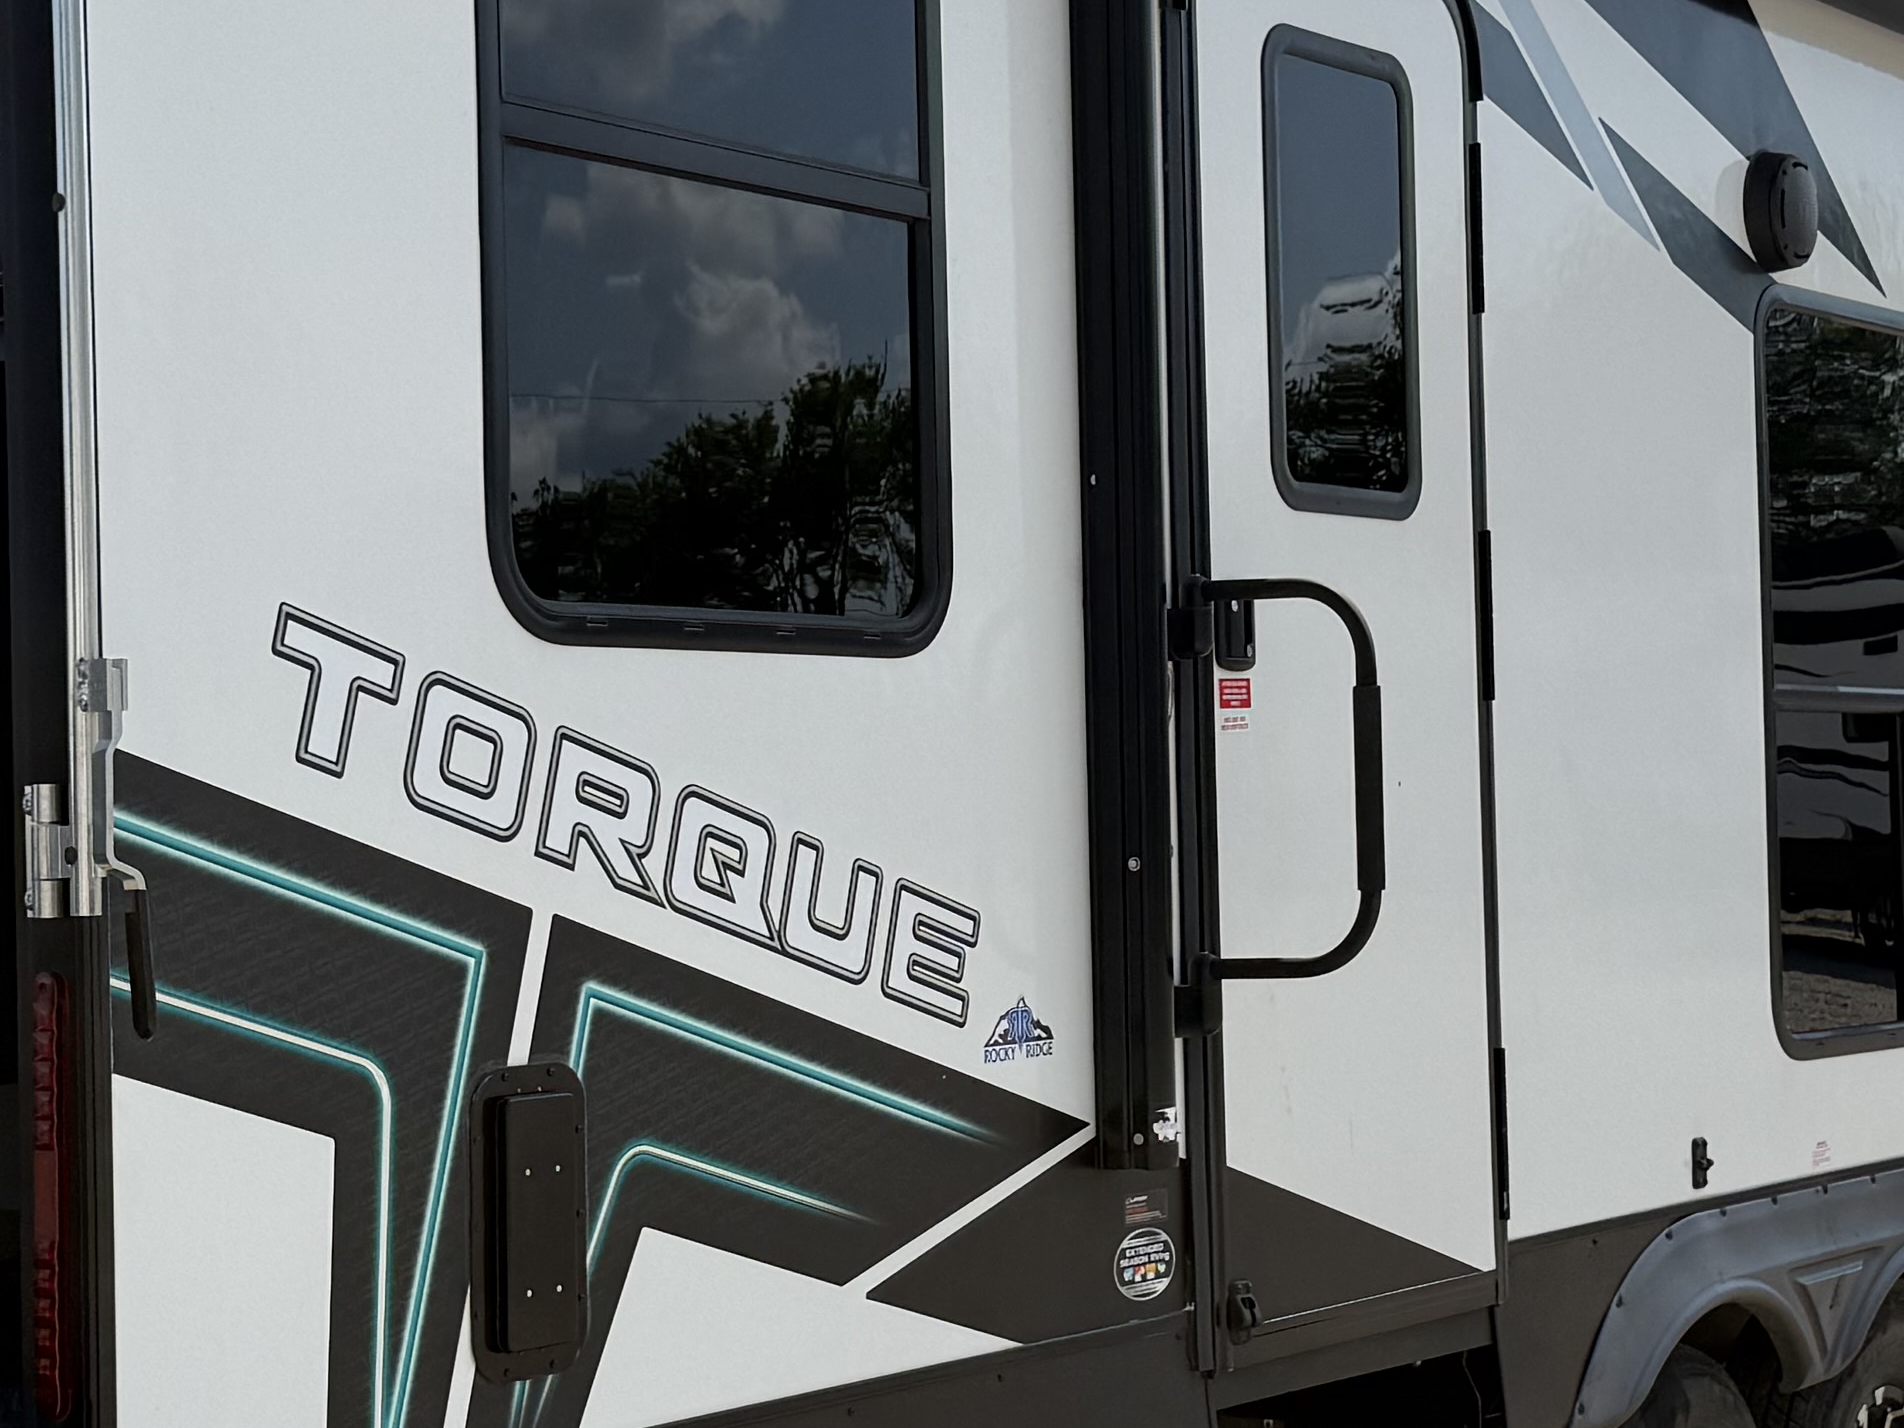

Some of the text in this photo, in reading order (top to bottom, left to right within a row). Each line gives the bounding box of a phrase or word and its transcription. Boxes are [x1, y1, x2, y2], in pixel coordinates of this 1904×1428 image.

[271, 601, 981, 1028] TORQUE
[984, 1041, 1053, 1064] ROCKY RIDGE
